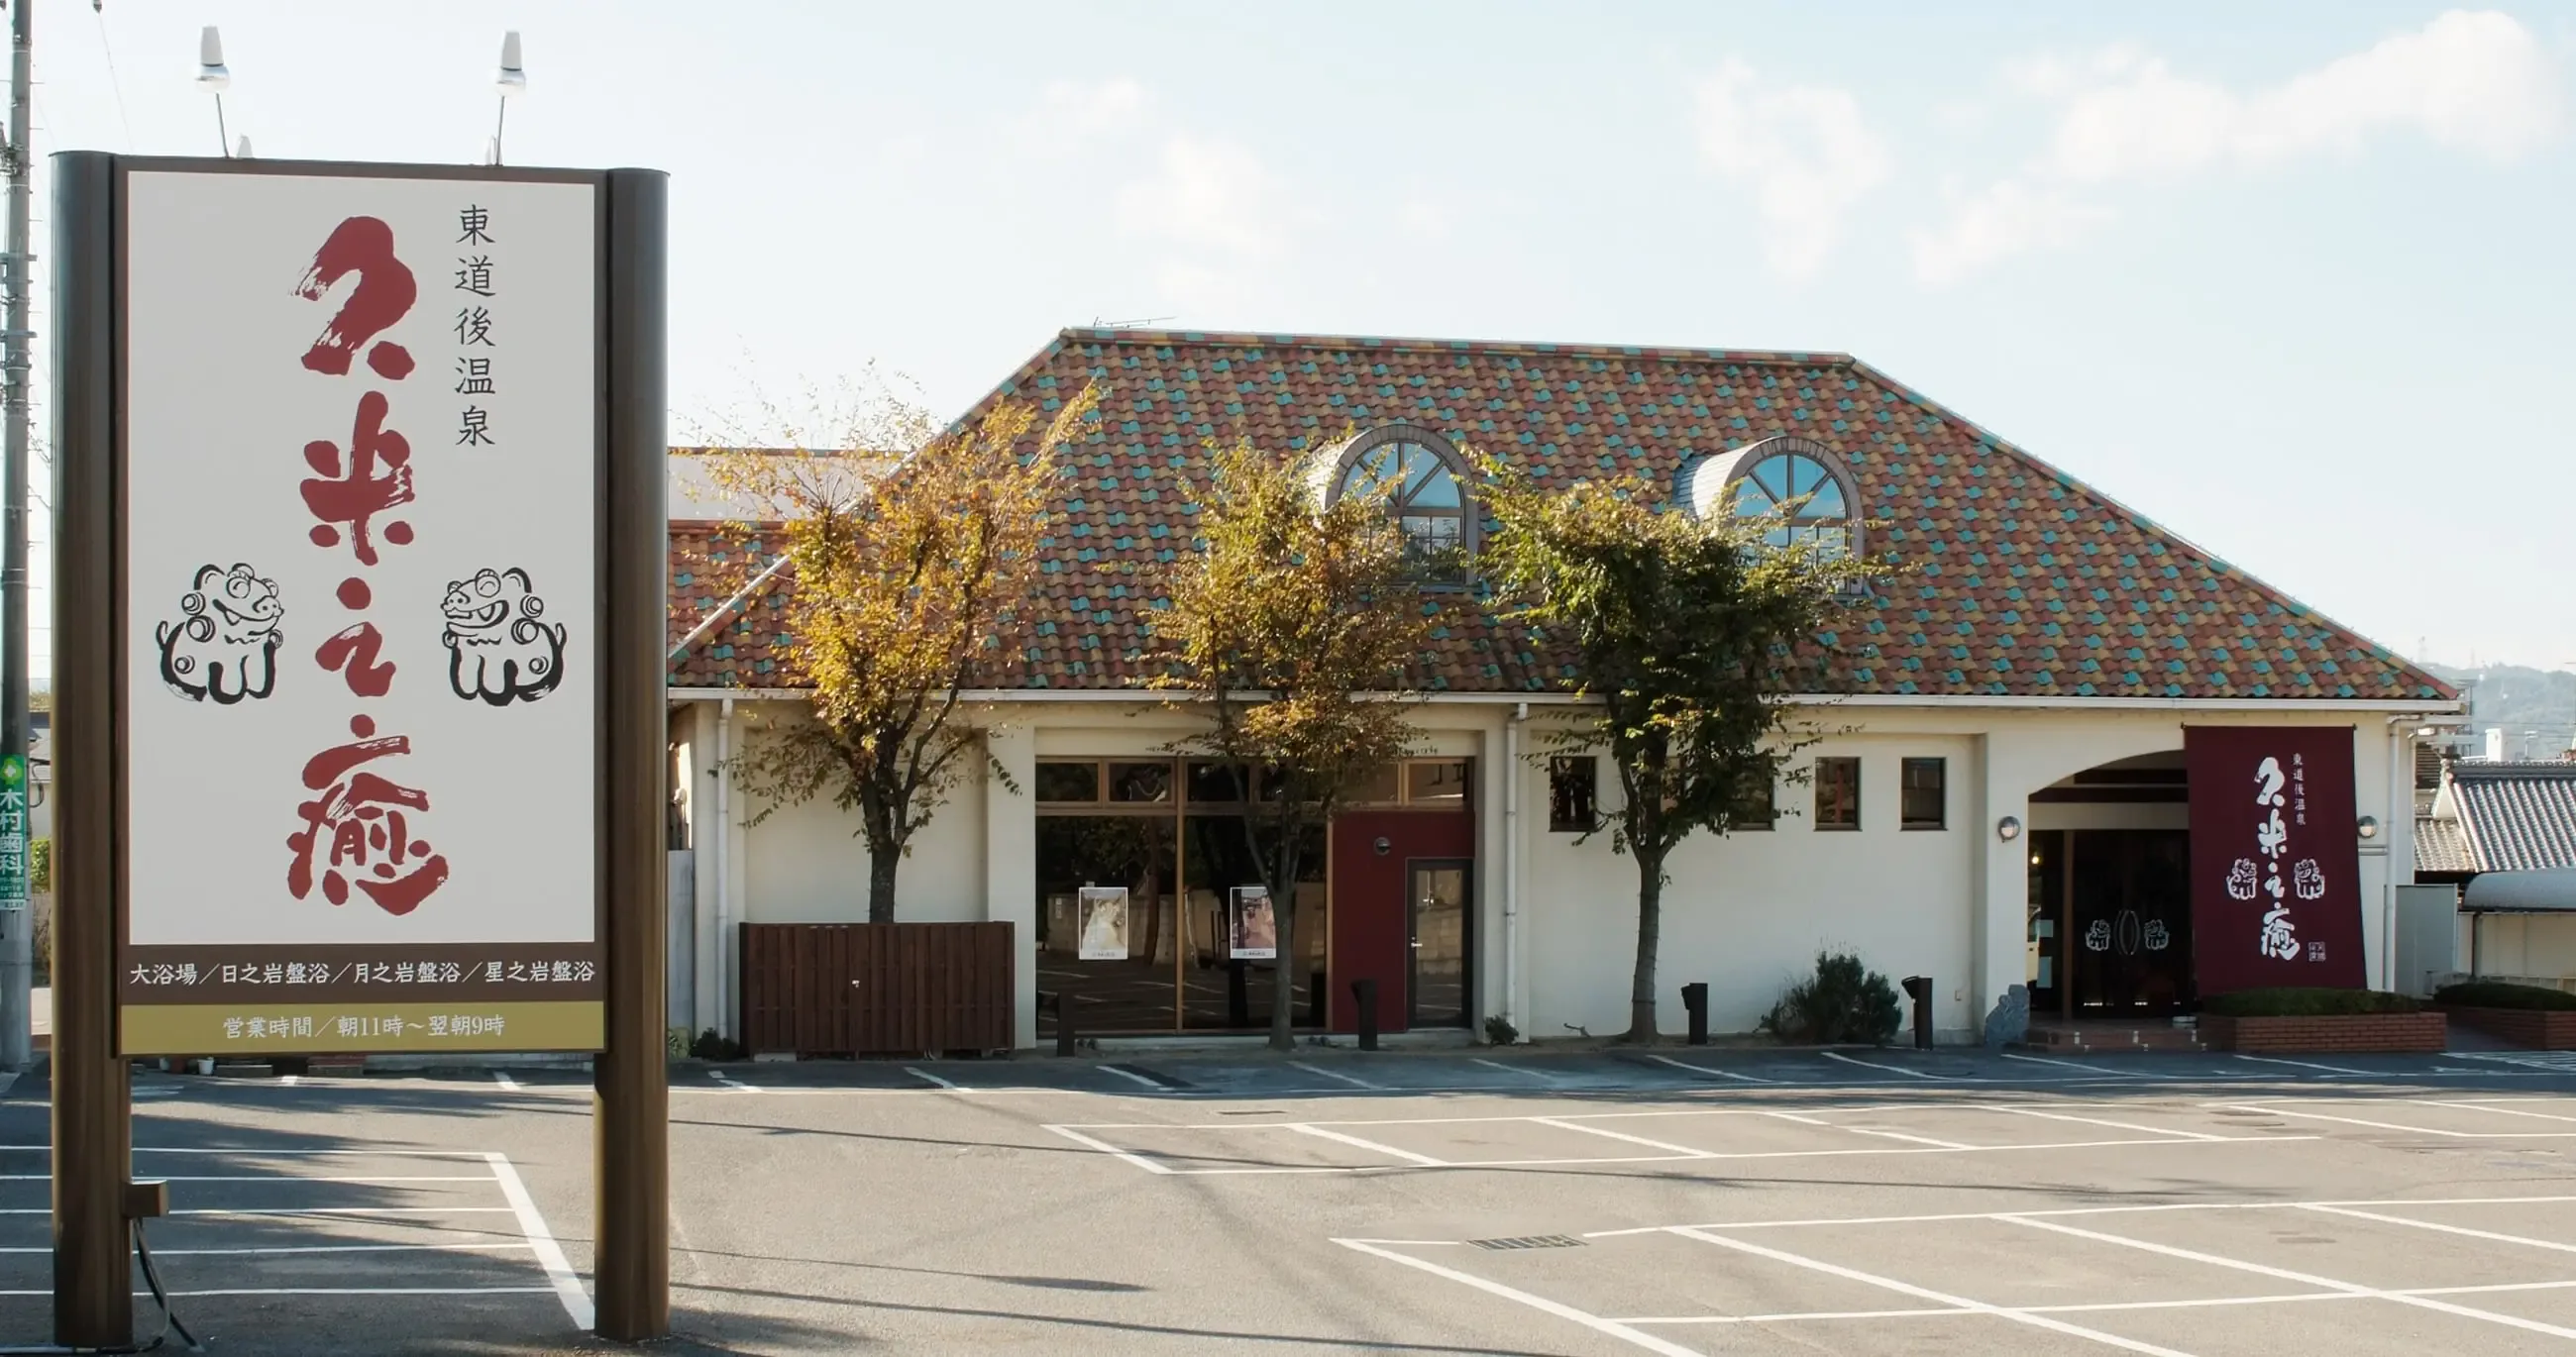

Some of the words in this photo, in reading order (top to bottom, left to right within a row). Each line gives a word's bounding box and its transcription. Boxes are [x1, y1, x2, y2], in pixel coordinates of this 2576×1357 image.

[454, 204, 496, 447] 東道後温泉
[288, 216, 448, 914] 久米之癒
[0, 788, 24, 876] 木村歯科
[2254, 757, 2301, 961] 久米之癒
[2293, 753, 2307, 825] 東道後温泉
